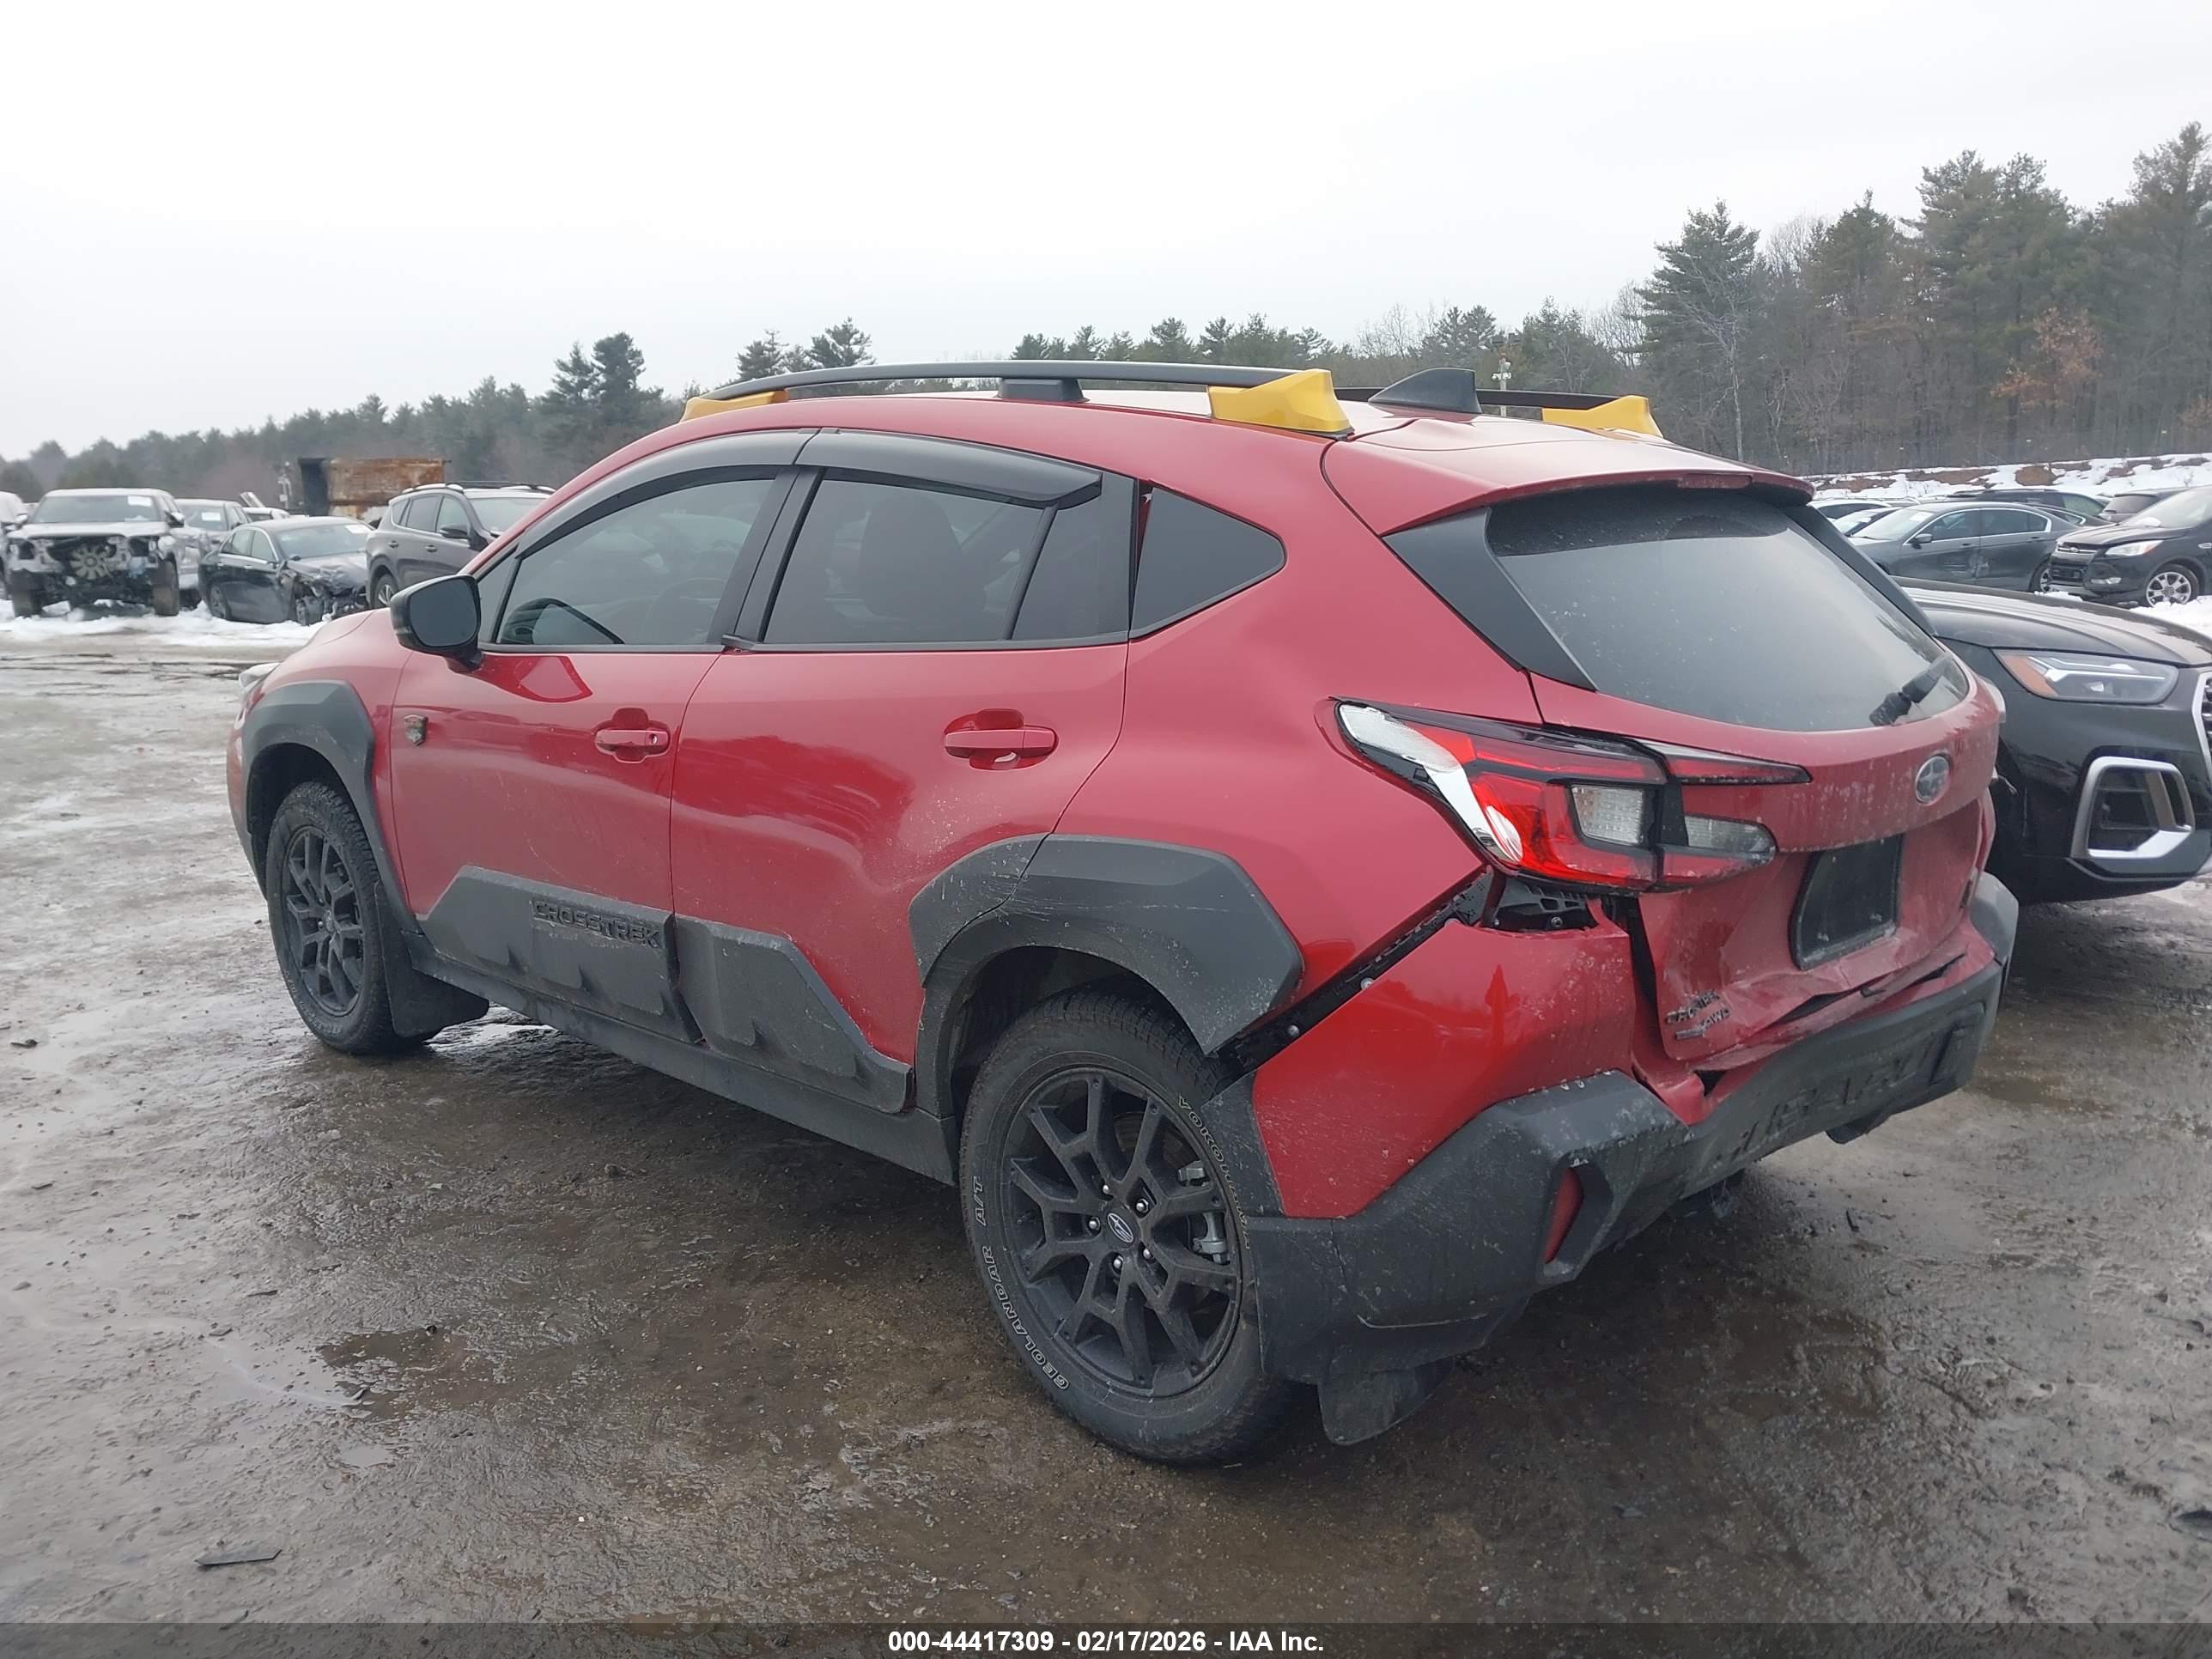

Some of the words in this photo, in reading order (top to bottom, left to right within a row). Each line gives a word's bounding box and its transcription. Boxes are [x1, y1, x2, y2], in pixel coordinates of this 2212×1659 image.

[532, 900, 659, 948] CROSSTREK
[973, 1176, 986, 1226] A/T
[981, 1245, 1069, 1389] GEOLANDAR
